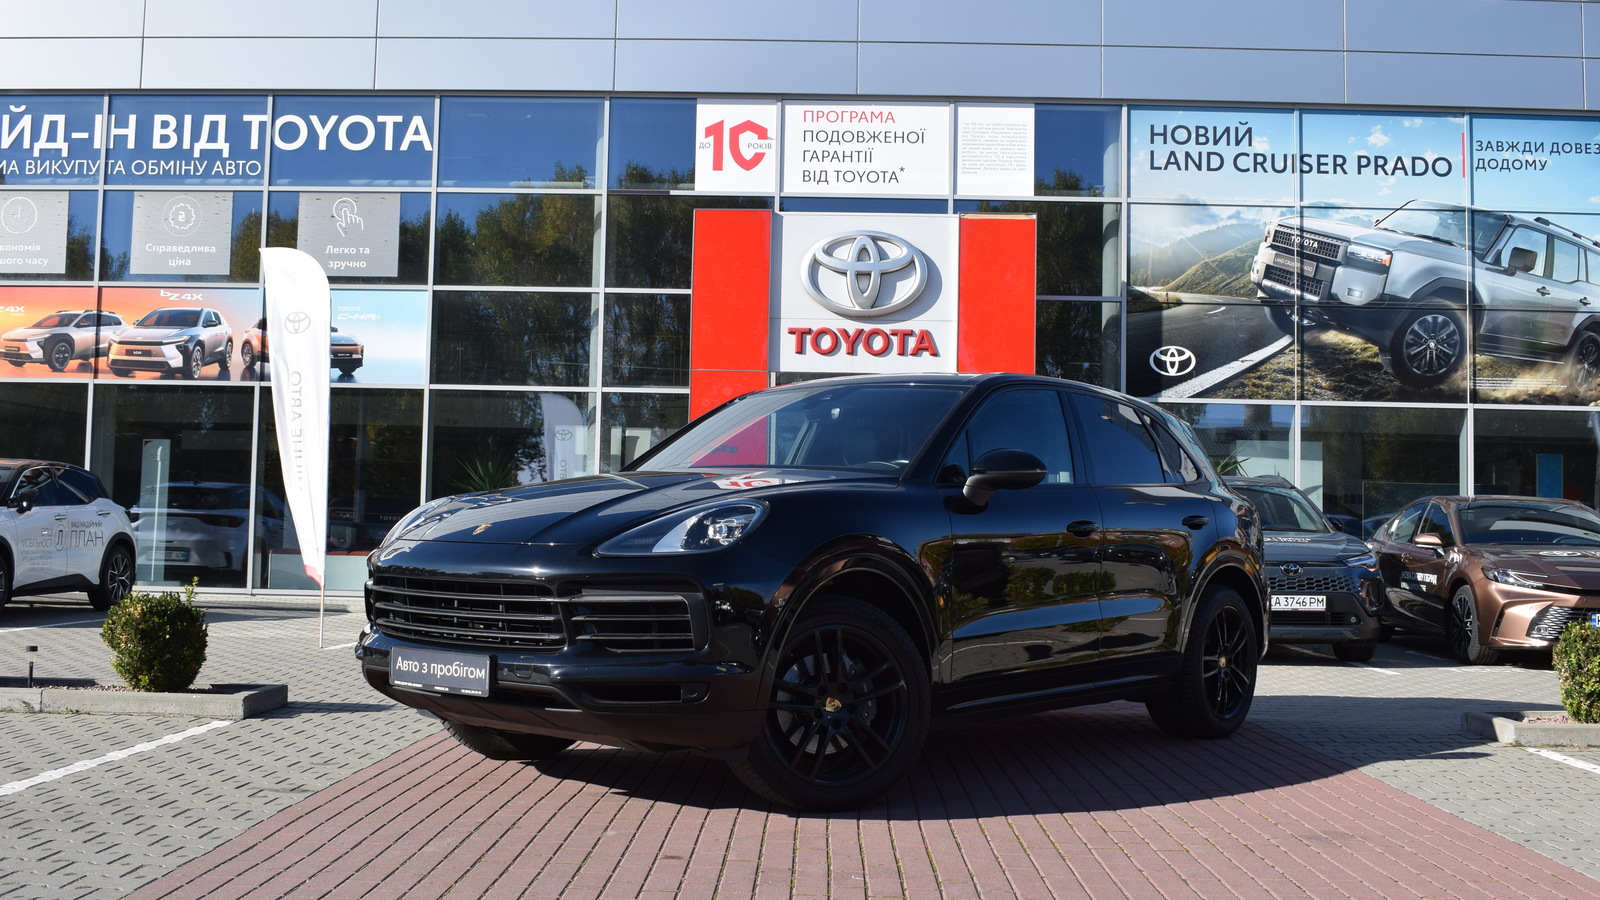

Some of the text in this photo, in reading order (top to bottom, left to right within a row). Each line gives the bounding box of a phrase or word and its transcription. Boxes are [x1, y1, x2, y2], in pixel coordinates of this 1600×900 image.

[803, 110, 895, 123] ПРОГРАМА
[152, 114, 229, 157] ВІД
[243, 114, 433, 151] TOYOTA
[803, 128, 926, 145] ПОДОВЖЕНОЇ
[1150, 121, 1252, 147] НОВИЙ
[802, 147, 874, 163] ГАРАНТІЇ
[1475, 140, 1600, 156] ЗАВЖДИ ДОВЕЗ
[25, 160, 100, 174] ВИКУПУ
[106, 160, 125, 175] ТА
[131, 160, 207, 175] ОБМІНУ
[211, 160, 261, 175] АВТО
[1150, 150, 1453, 177] LAND CRUISER PRADO
[1475, 158, 1547, 172] ДОДОМУ
[802, 170, 829, 185] ВІД
[0, 242, 40, 251] кономія
[145, 243, 216, 254] Справедлива
[325, 245, 356, 254] Легко
[25, 258, 48, 267] часу
[169, 256, 191, 267] ціна
[328, 260, 366, 269] зручно
[787, 327, 938, 356] TOYOTA
[70, 530, 104, 547] ПЛАН
[1271, 597, 1324, 607] A 3746 PM
[396, 656, 485, 679] Авто з пробігом
